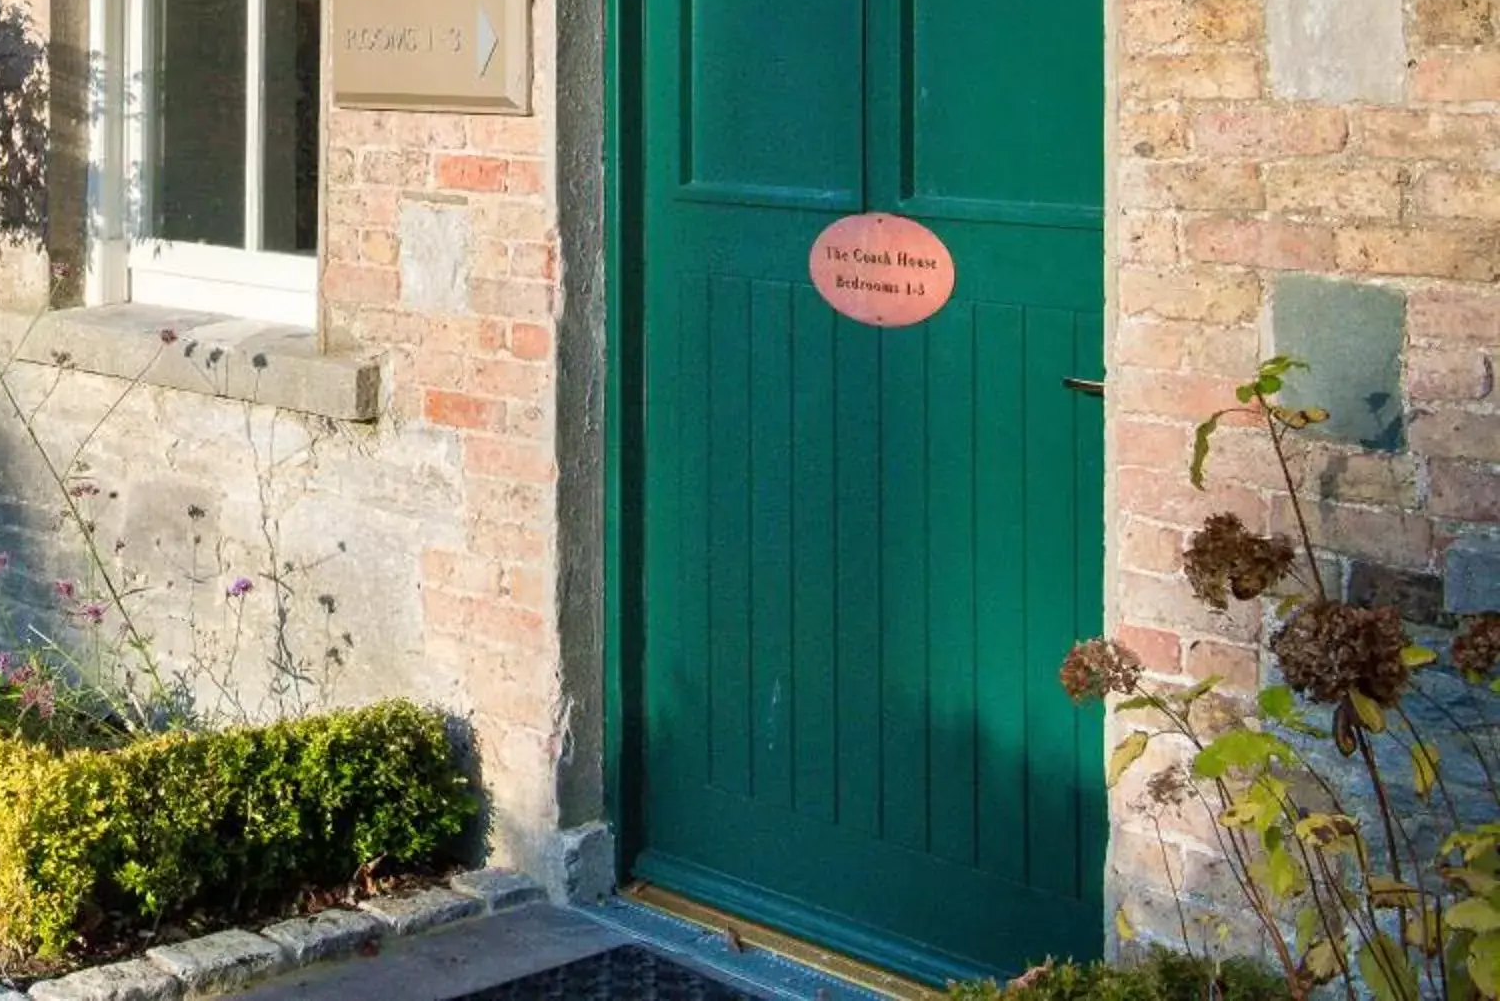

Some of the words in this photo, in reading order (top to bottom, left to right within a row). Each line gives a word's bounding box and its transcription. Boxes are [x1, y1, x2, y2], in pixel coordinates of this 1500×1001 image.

[347, 27, 418, 52] ROOMS
[826, 246, 849, 262] The
[853, 248, 892, 266] Coach
[897, 251, 938, 270] House
[836, 274, 900, 294] Bedrooms
